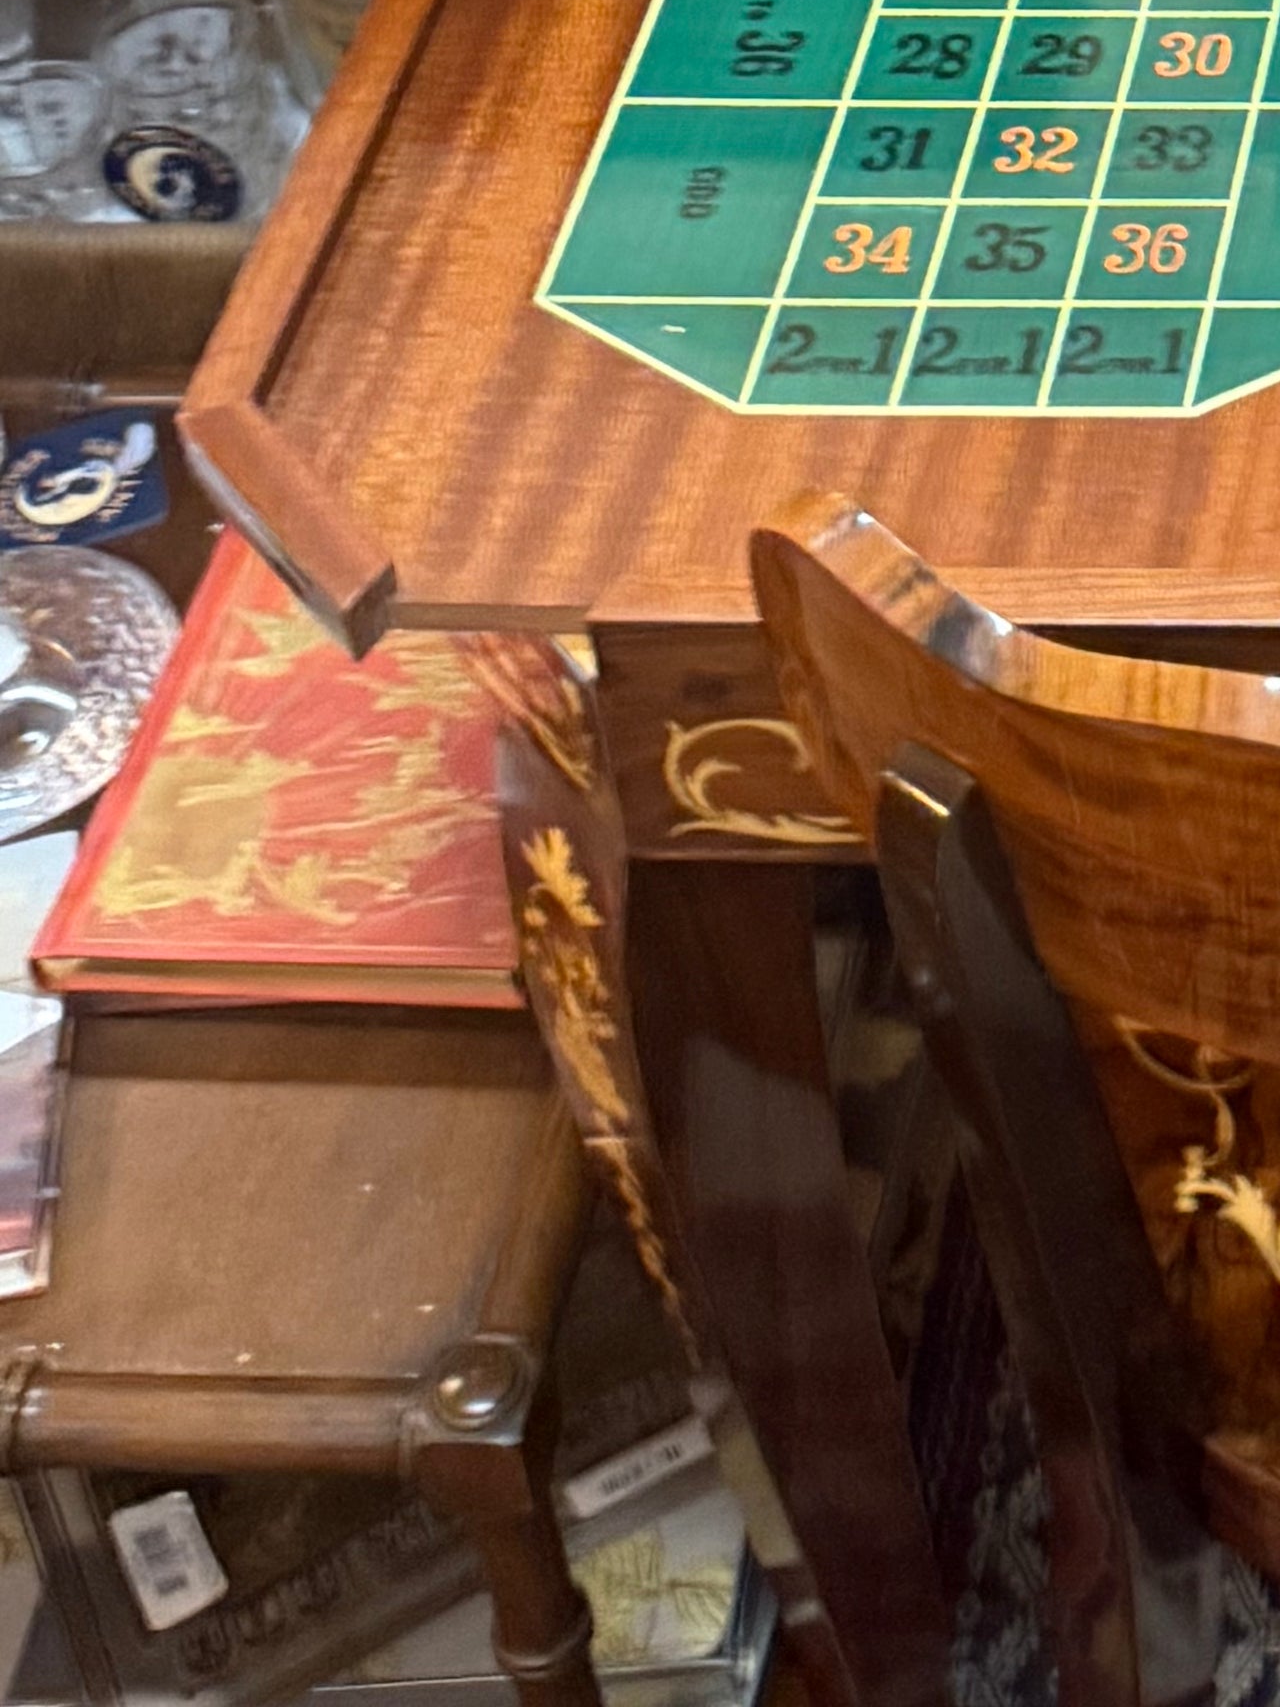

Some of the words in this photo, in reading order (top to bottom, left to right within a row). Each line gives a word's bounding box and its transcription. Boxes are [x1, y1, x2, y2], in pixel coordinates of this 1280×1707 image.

[887, 33, 973, 81] 28
[1016, 33, 1101, 77] 29
[1153, 32, 1232, 78] 30
[859, 125, 933, 173] 31
[994, 126, 1078, 174] 32
[1132, 124, 1214, 173] 33
[824, 223, 911, 275] 34
[961, 222, 1050, 274] 35
[1103, 223, 1189, 274] 36
[768, 324, 815, 375] 2
[913, 326, 957, 377] 2
[1058, 324, 1103, 375] 2
